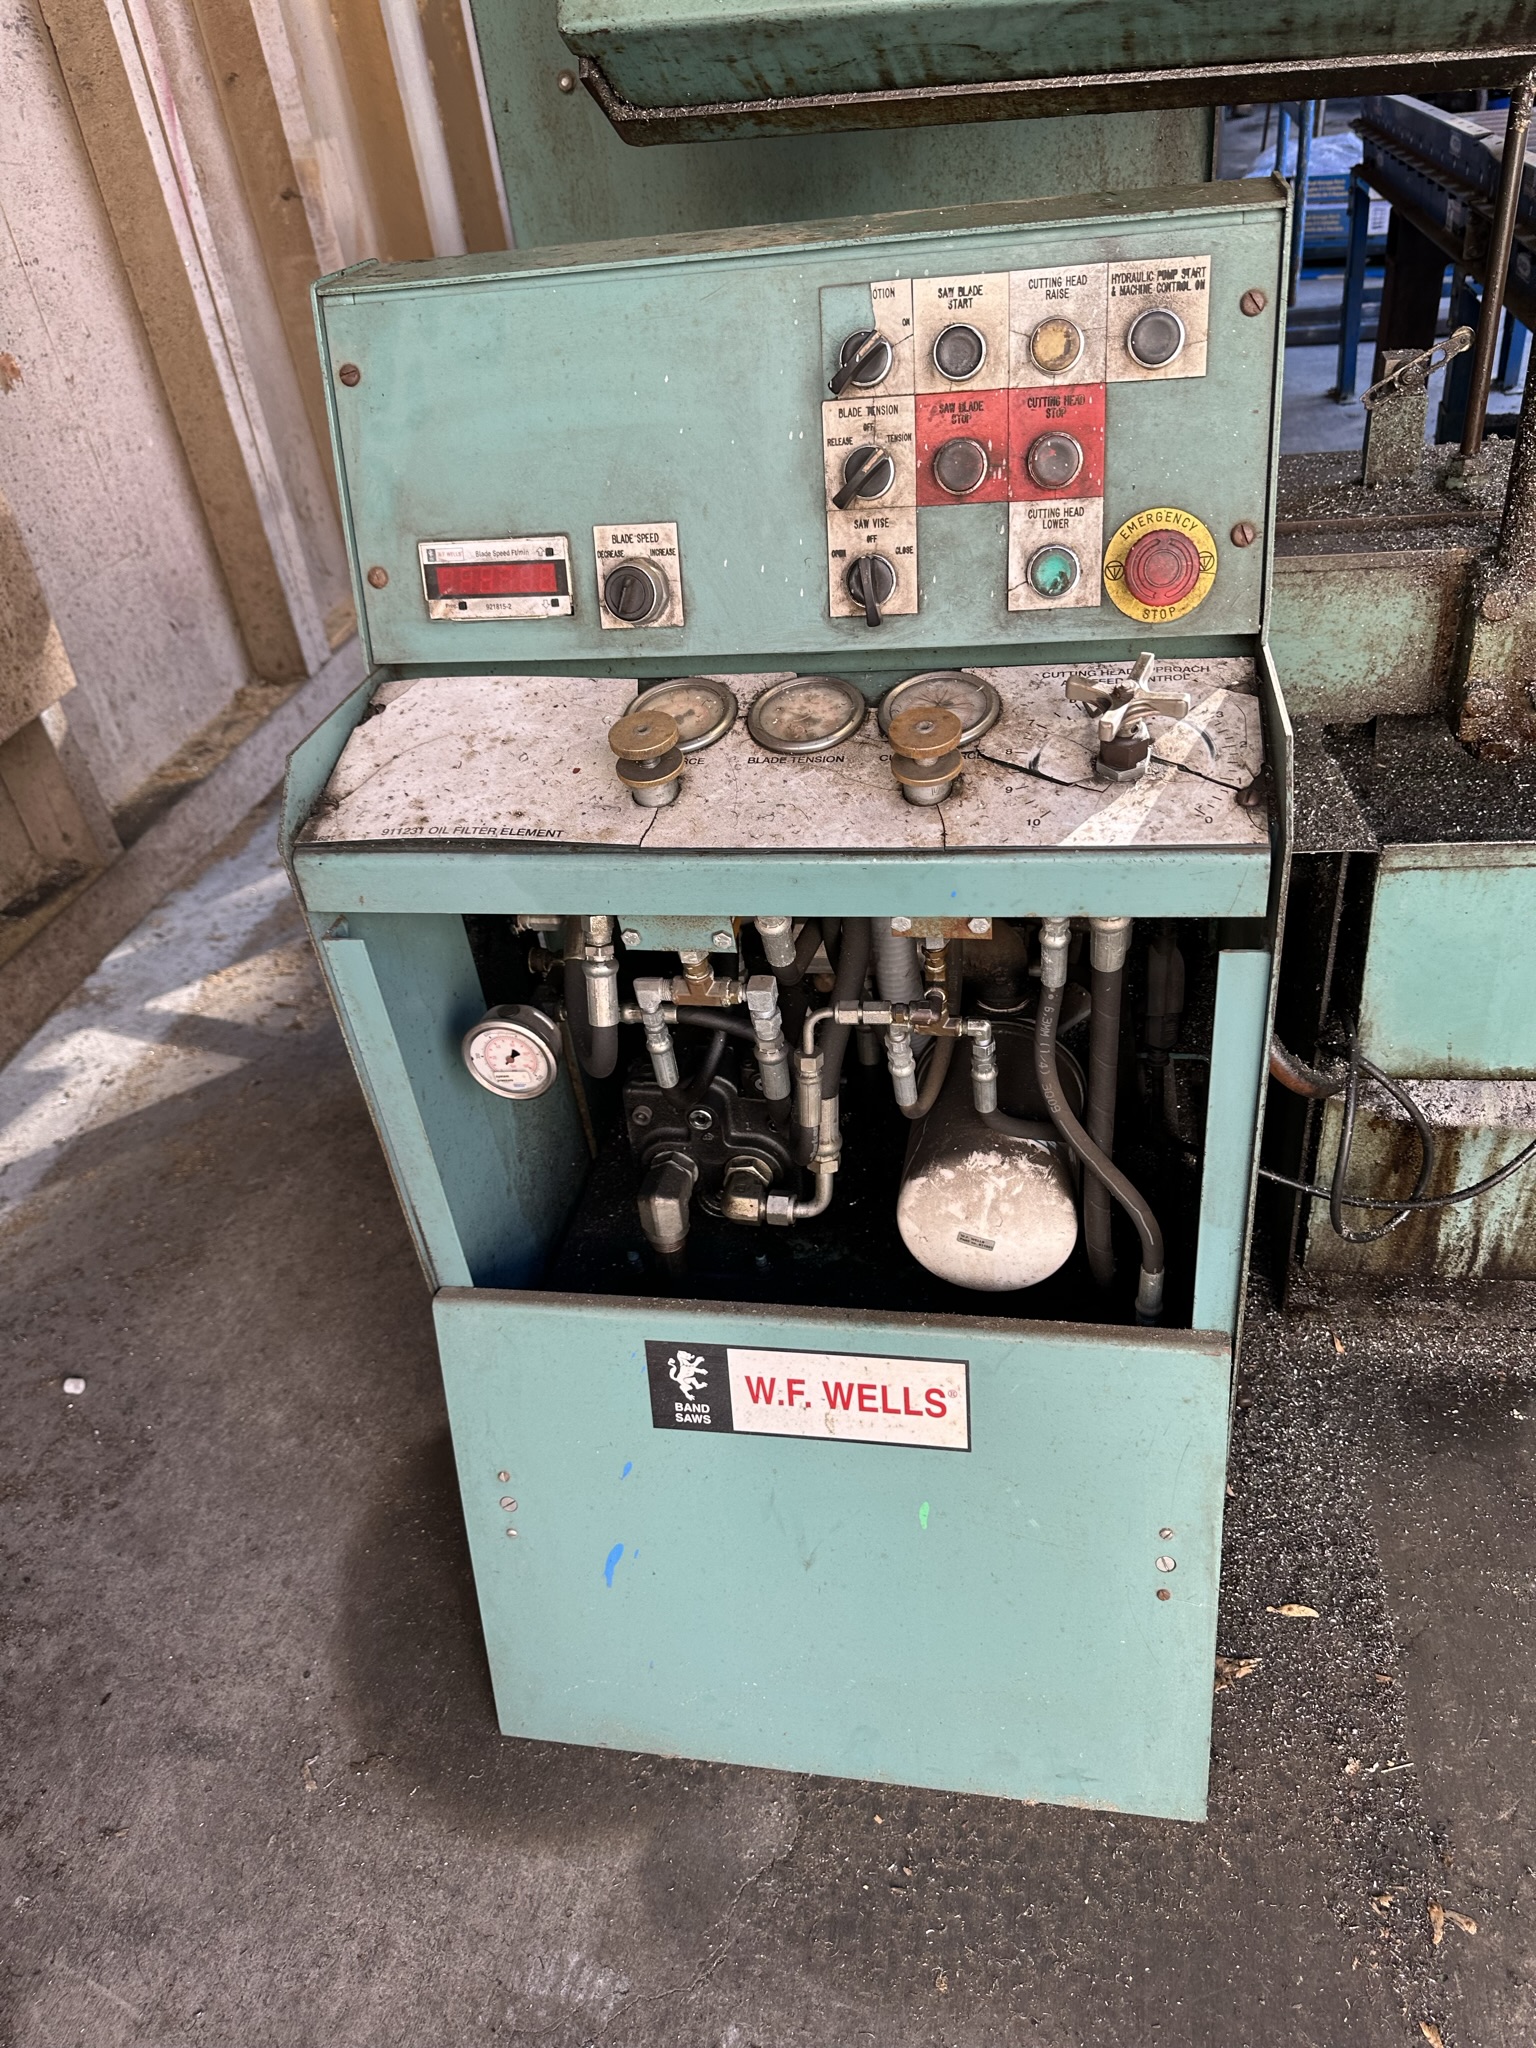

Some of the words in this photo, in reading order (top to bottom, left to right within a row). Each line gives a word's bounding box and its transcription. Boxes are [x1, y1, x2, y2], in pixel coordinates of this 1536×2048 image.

[1111, 270, 1155, 284] HYDRAULIC
[1157, 268, 1178, 281] PUMP
[1181, 266, 1207, 279] START
[1028, 276, 1062, 290] CUTTING
[1065, 274, 1087, 287] HEAD
[1111, 285, 1116, 297] &
[1119, 283, 1153, 296] MACHINE
[1156, 280, 1191, 294] CONTROL
[1195, 279, 1206, 291] ON
[872, 287, 896, 300] OTION
[938, 287, 954, 299] SAW
[957, 284, 983, 298] BLADE
[1045, 288, 1069, 300] RAISE
[947, 297, 973, 310] START
[902, 317, 911, 327] ON
[1027, 395, 1060, 409] CUTTING
[1063, 393, 1086, 407] HEAD
[838, 406, 863, 418] BLADE
[865, 404, 899, 417] TENSION
[939, 402, 956, 415] SAW
[958, 400, 985, 413] BLADE
[1045, 407, 1067, 419] STOP
[951, 412, 972, 425] STOP
[863, 422, 874, 432] OFF
[827, 436, 853, 447] RELEASE
[887, 433, 912, 443] TENSION
[1028, 508, 1061, 519] CUTTING
[1063, 506, 1085, 517] HEAD
[854, 519, 870, 529] SAW
[872, 517, 890, 529] VISE
[1042, 518, 1069, 529] LOWER
[1119, 511, 1199, 541] EMERGENCY
[611, 533, 634, 545] BLADE
[636, 532, 660, 544] SPEED
[866, 534, 878, 543] OFF
[475, 549, 492, 558] Blade
[493, 549, 510, 559] Speed
[511, 548, 530, 557] Ft/min
[597, 549, 625, 559] DECREASE
[649, 547, 676, 557] INCREASE
[831, 549, 846, 558] OPEN
[895, 545, 914, 555] CLOSE
[485, 603, 512, 611] 921815-2
[1142, 606, 1176, 620] STOP
[1042, 669, 1097, 679] CUTTING
[1153, 664, 1210, 674] PROACH
[1148, 673, 1190, 682] NTROL
[1216, 710, 1224, 718] 3
[1240, 740, 1248, 748] 2
[747, 756, 787, 764] BLADE
[791, 754, 845, 764] TENSION
[1005, 786, 1013, 794] 9
[1026, 818, 1041, 827] 10
[1204, 815, 1213, 824] 0
[381, 826, 424, 836] 911231
[428, 826, 449, 835] OIL
[452, 826, 497, 835] FILTER
[500, 827, 564, 838] ELEMENT
[1038, 1042, 1051, 1075] (1/4)
[744, 1374, 812, 1409] W.F.
[674, 1402, 710, 1413] BAND
[675, 1412, 712, 1425] SAWS
